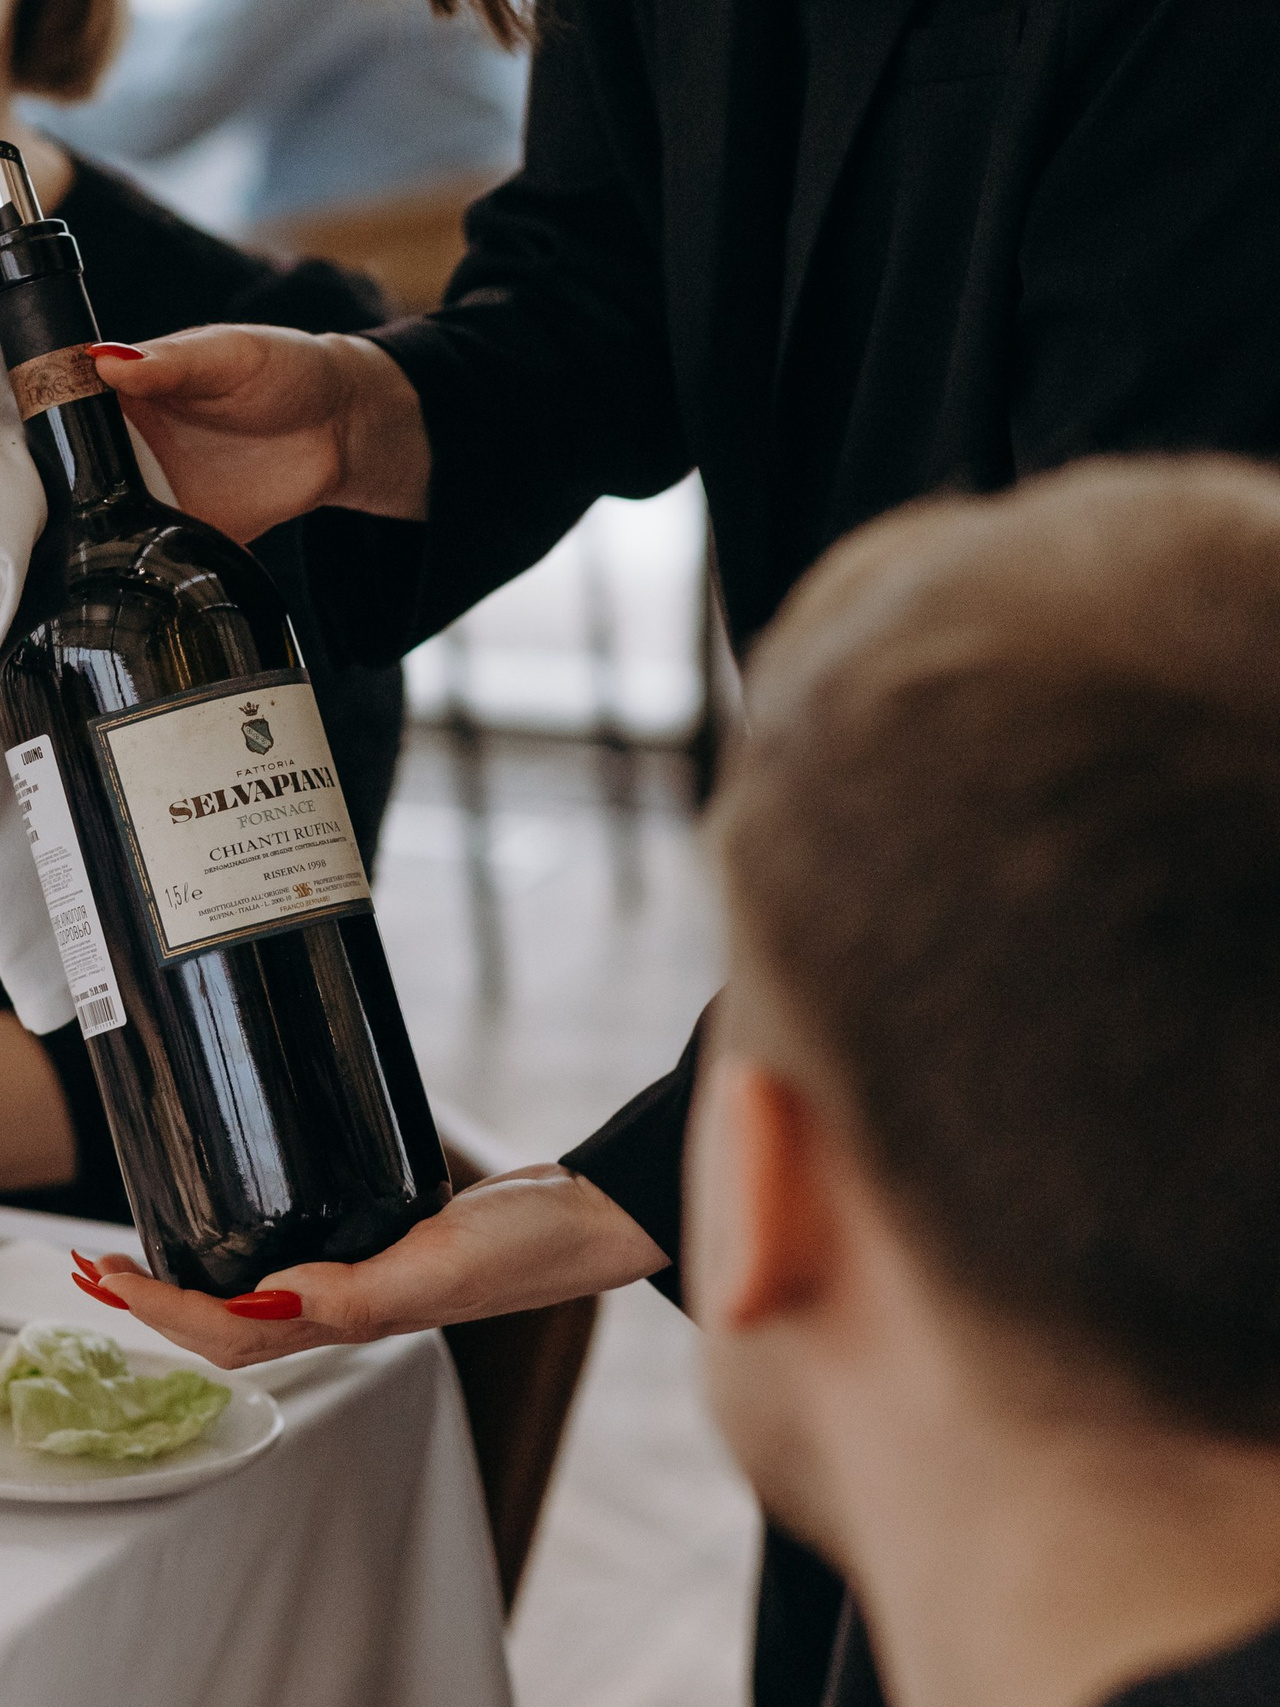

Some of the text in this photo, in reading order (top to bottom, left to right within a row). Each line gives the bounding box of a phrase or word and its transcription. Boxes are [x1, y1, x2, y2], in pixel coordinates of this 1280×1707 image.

[236, 759, 295, 778] FATTORIA
[169, 766, 336, 824] SELVAPIANA
[237, 800, 316, 829] FORNACE
[209, 821, 341, 862] CHIANTI RUFINA
[263, 859, 327, 881] RISERVA 1998
[198, 898, 250, 916] IMBOTTIGLIATO
[238, 904, 261, 914] ITALIA
